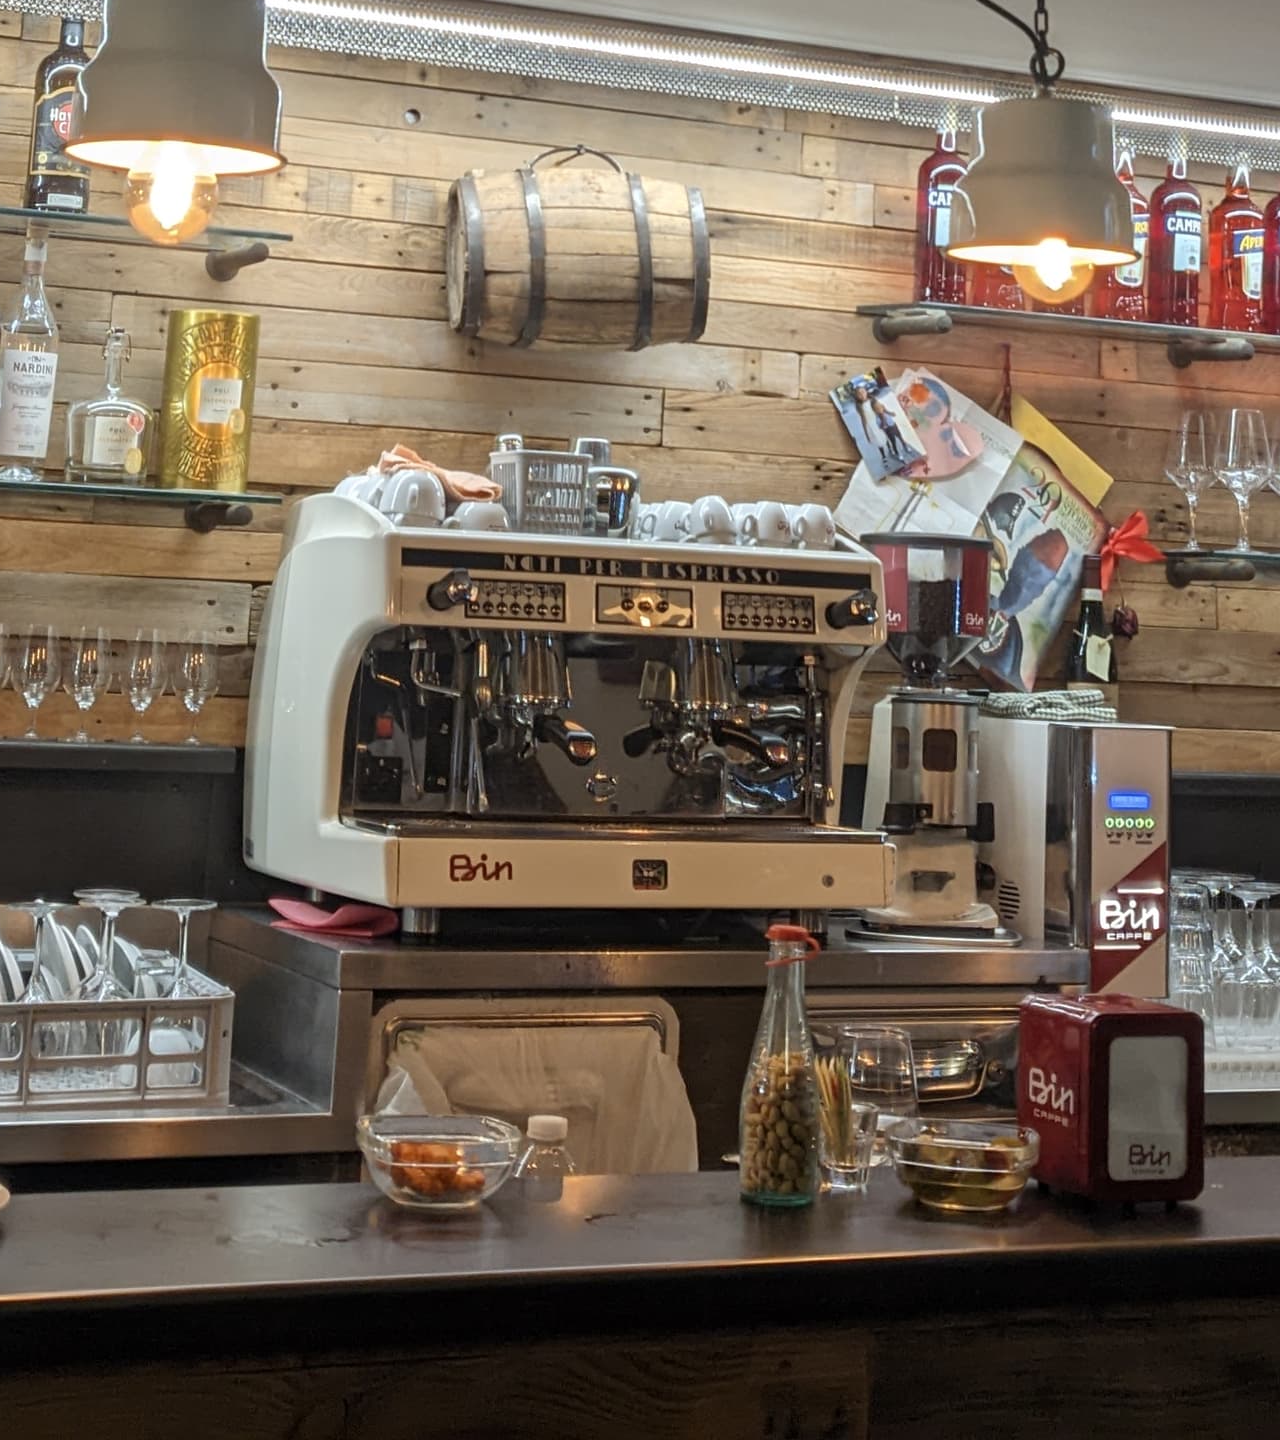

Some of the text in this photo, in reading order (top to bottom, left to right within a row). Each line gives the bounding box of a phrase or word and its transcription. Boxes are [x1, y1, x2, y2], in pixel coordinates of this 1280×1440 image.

[13, 362, 54, 375] NARDINI
[579, 558, 624, 577] PER
[449, 853, 513, 882] Bin
[1099, 898, 1160, 931] Bin
[1028, 1067, 1075, 1115] Bin
[1128, 1143, 1171, 1167] Bin
